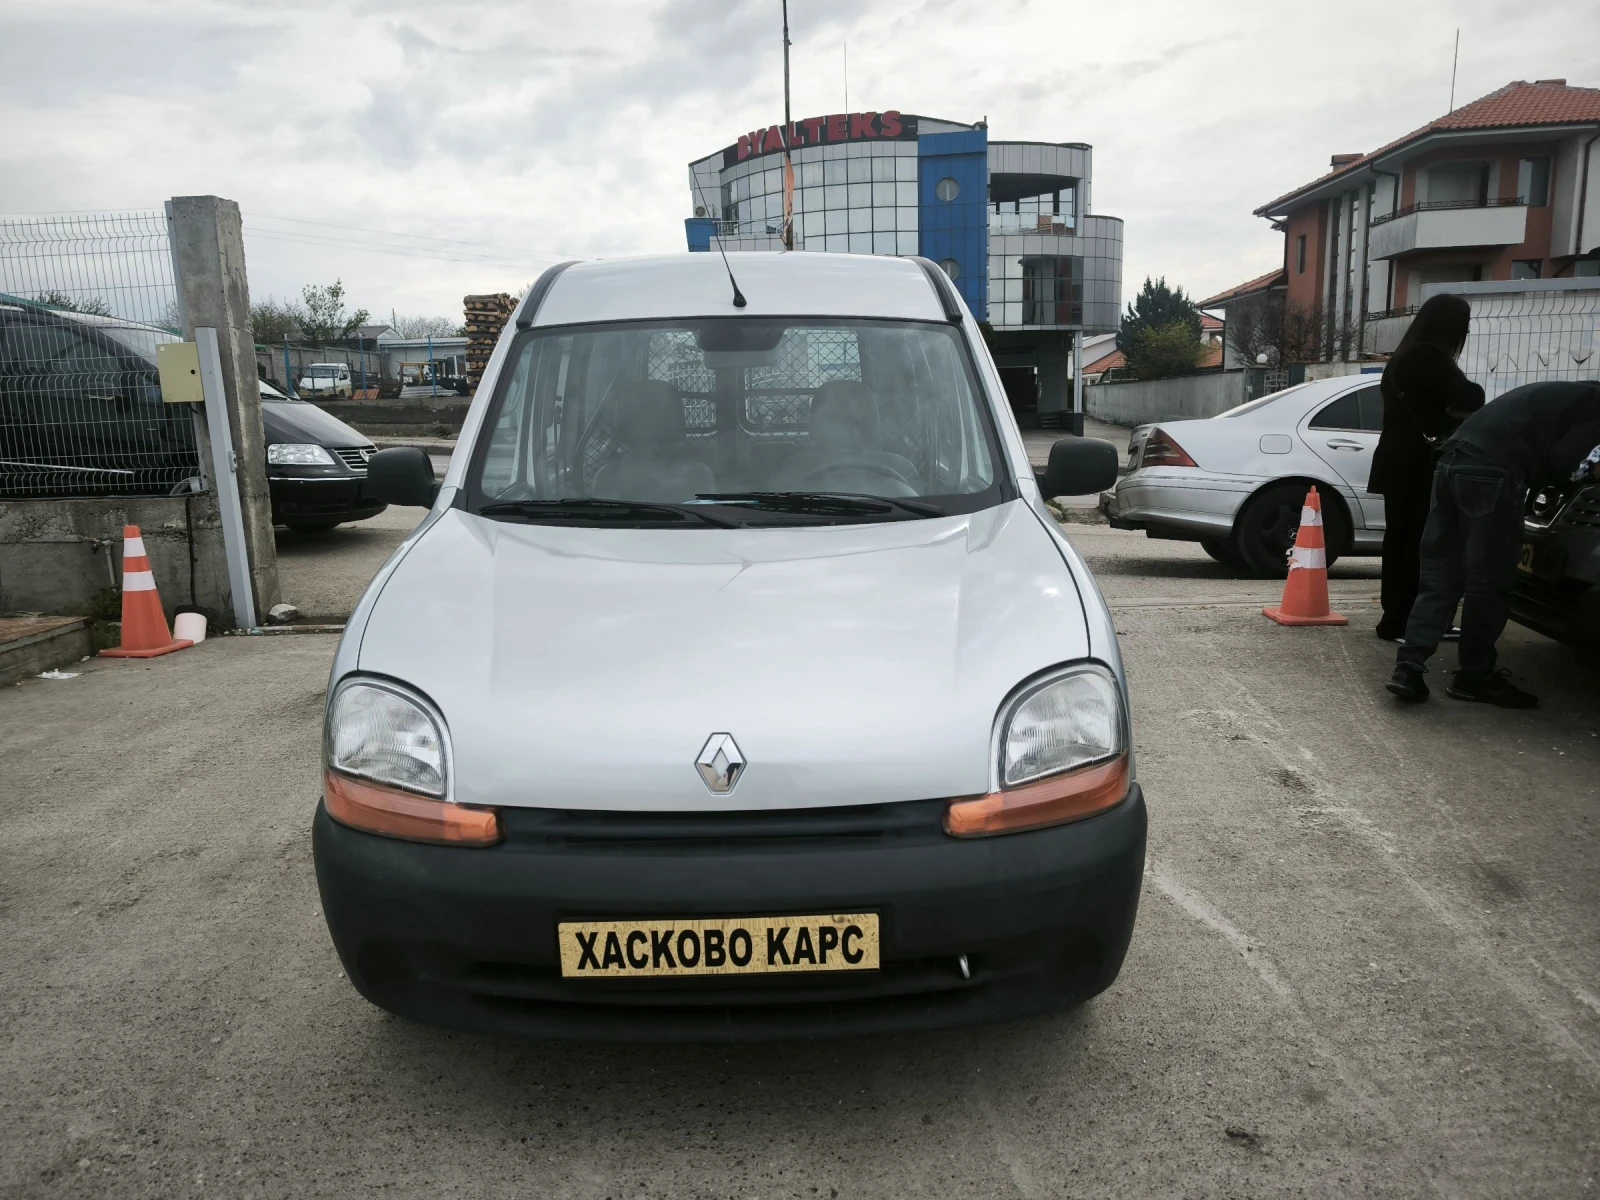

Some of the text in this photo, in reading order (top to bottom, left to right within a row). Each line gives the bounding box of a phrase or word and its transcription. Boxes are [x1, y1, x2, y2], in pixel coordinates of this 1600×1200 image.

[737, 110, 904, 161] BYALTEKS
[575, 924, 864, 970] ХАСКОВО КАРС
